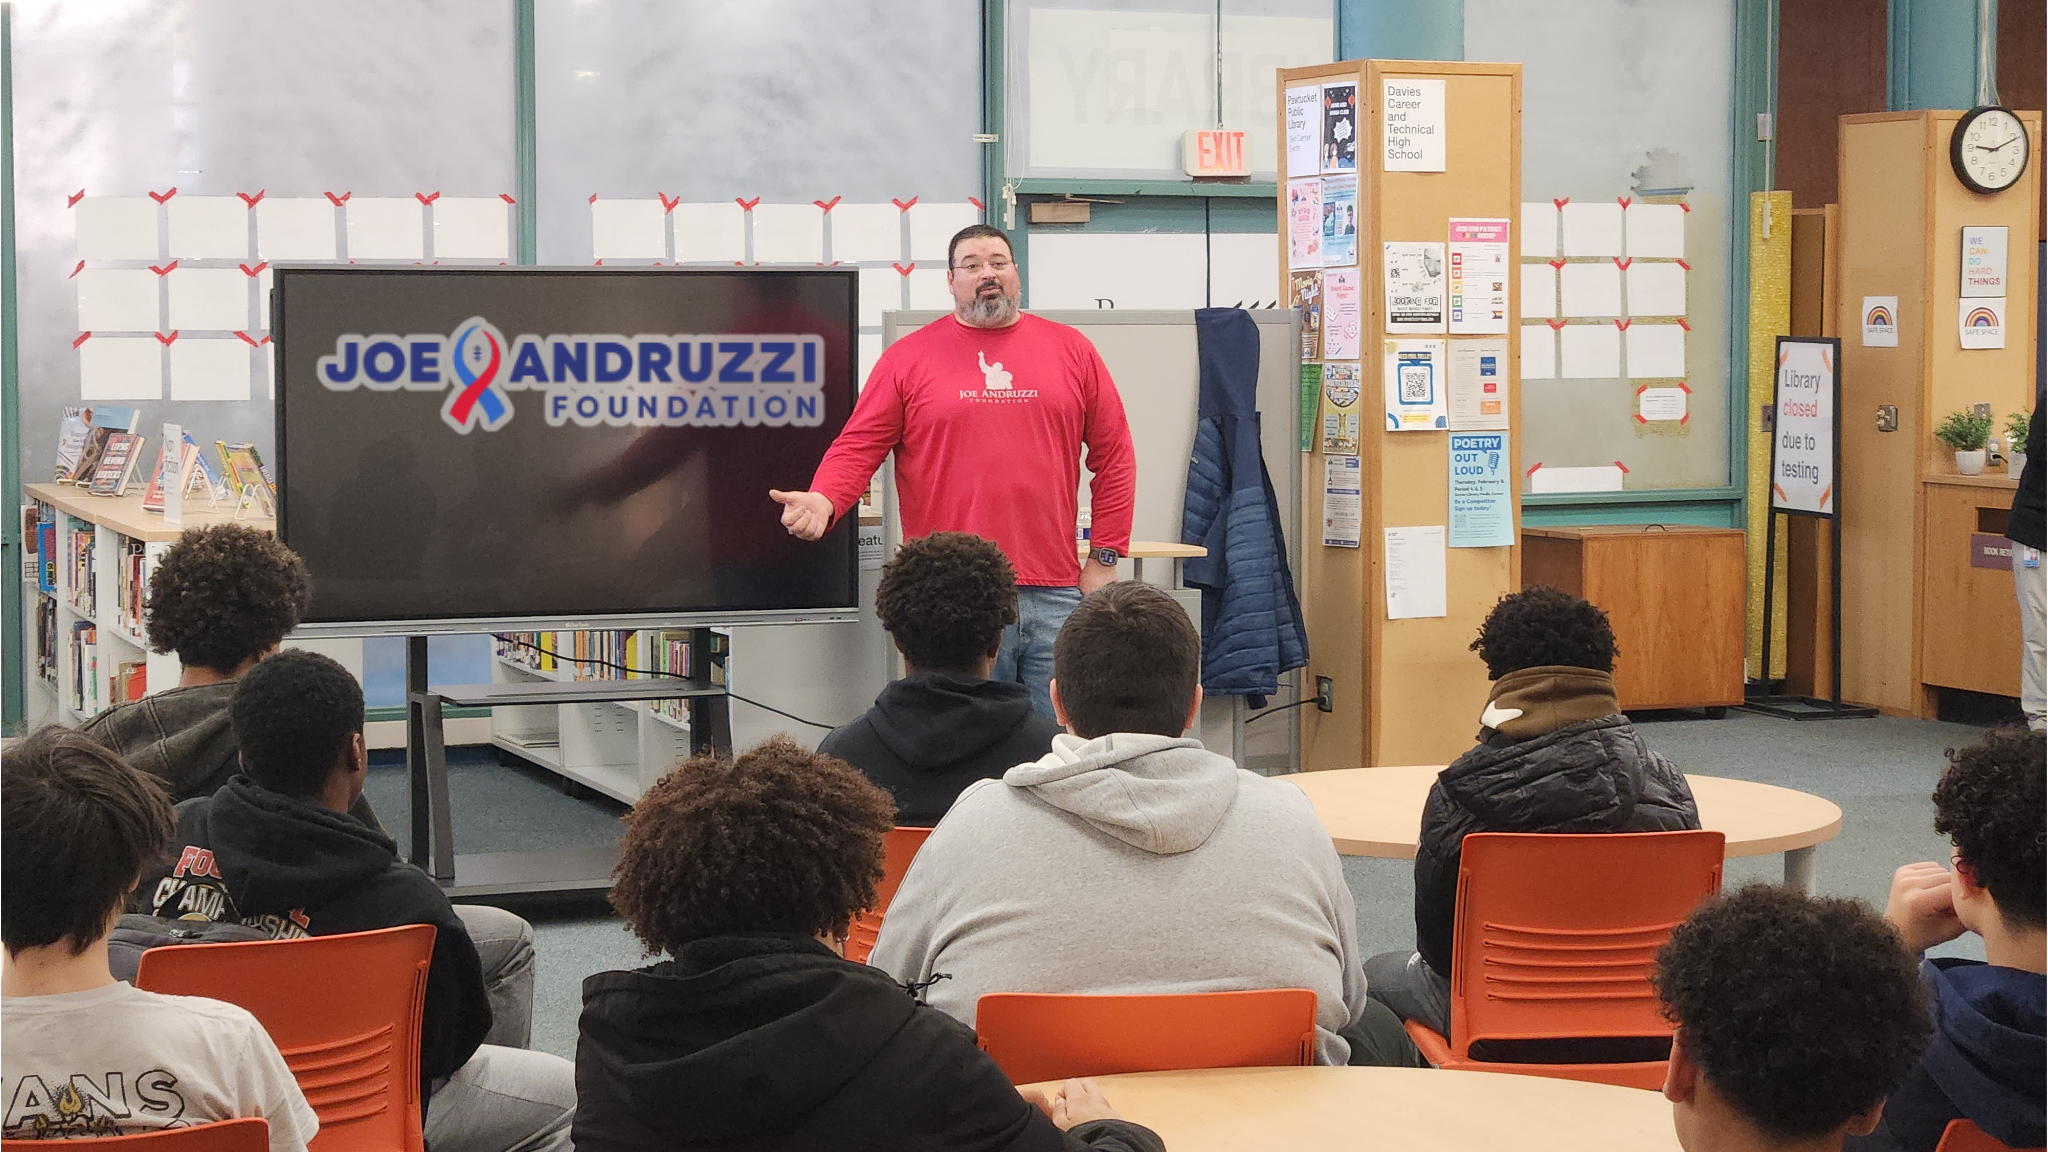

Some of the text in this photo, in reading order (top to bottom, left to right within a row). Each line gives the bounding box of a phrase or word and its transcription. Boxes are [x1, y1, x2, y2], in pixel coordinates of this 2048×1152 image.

[1388, 86, 1421, 96] Davies
[1288, 93, 1317, 105] Pawtucket
[1388, 98, 1421, 109] Career
[1288, 107, 1304, 117] Public
[1388, 112, 1406, 121] and
[1288, 120, 1306, 130] Library
[1979, 121, 1986, 130] 11
[1988, 117, 1997, 126] 12
[2004, 122, 2008, 130] 1
[1387, 124, 1434, 134] Technical
[1970, 132, 1980, 141] 10
[1388, 136, 1411, 149] High
[1197, 131, 1244, 172] EXIT
[1967, 143, 1974, 152] 9
[2013, 146, 2019, 155] 3
[1388, 149, 1423, 159] School
[1971, 156, 1978, 165] 8
[2009, 158, 2015, 166] 4
[1980, 167, 1985, 176] 7
[2000, 168, 2007, 177] 5
[1988, 172, 1995, 181] 6
[1969, 237, 1983, 245] WE
[1969, 247, 1987, 255] CAN
[325, 341, 816, 383] JOE ANDRUZZI
[1784, 369, 1821, 393] Library
[959, 390, 1038, 399] JOE ANDRUZZI
[552, 395, 817, 419] FOUNDATION
[1783, 398, 1818, 418] closed
[1454, 437, 1500, 448] POETRY
[1782, 431, 1815, 450] due to
[1455, 453, 1478, 462] OUT
[1455, 466, 1484, 475] LOUD
[1781, 460, 1819, 485] testing
